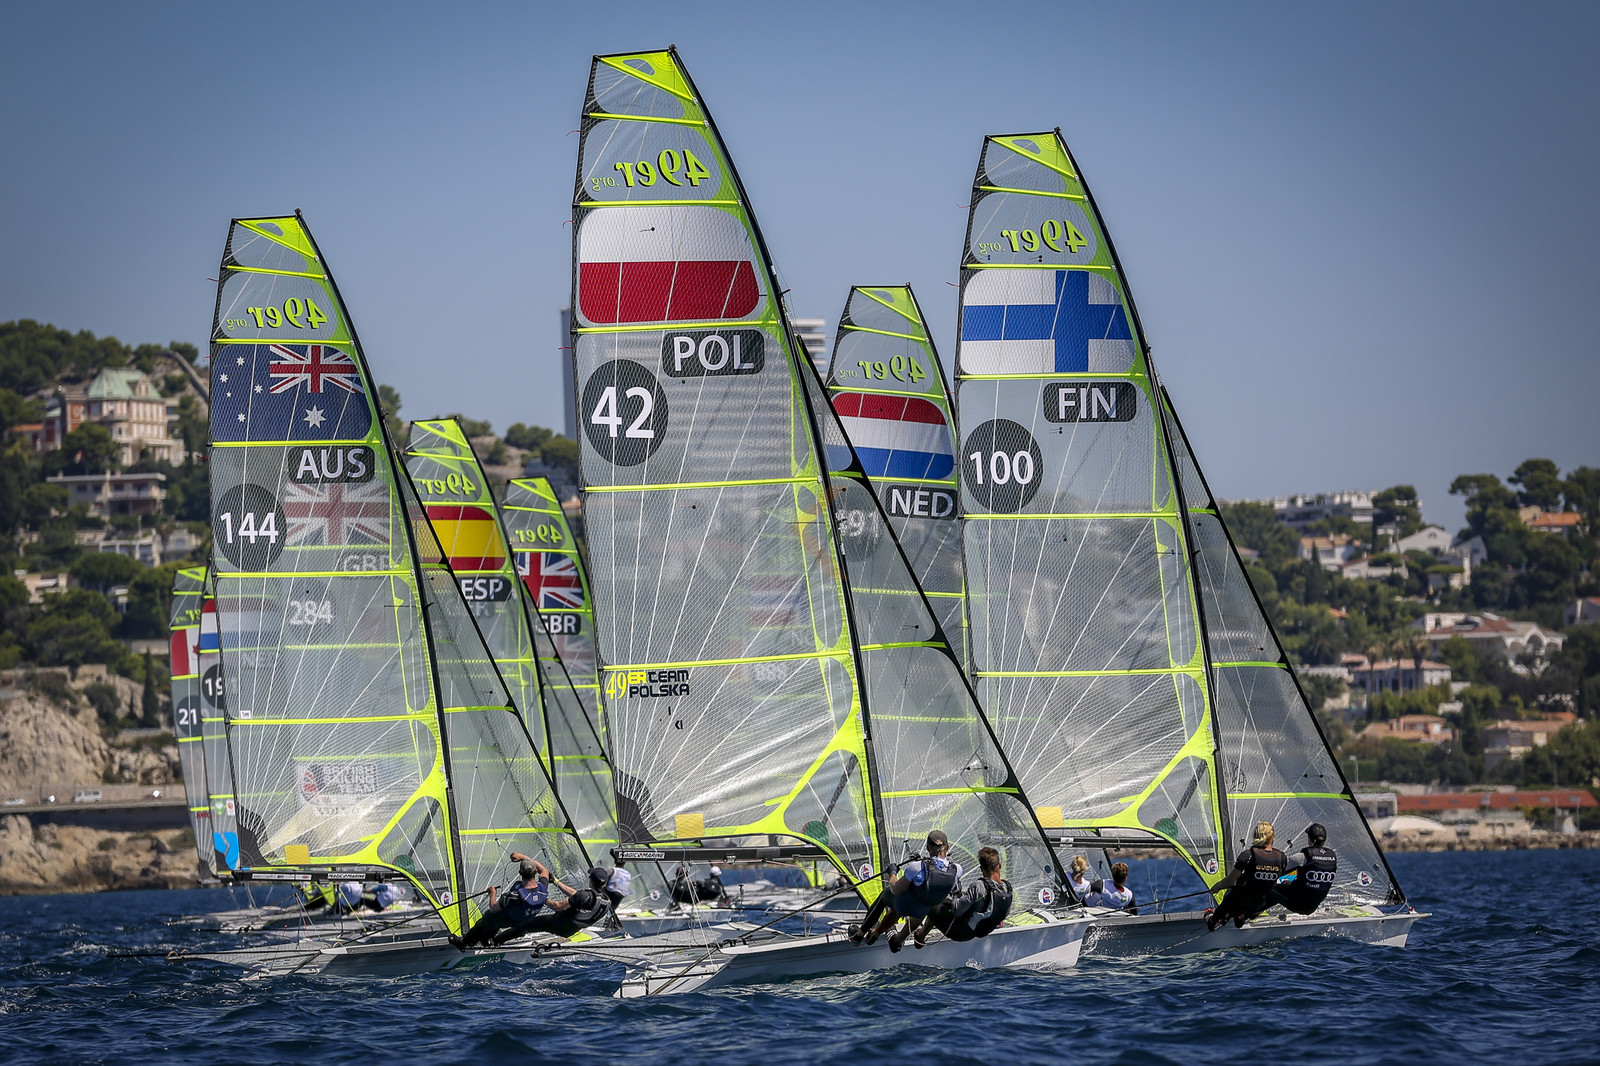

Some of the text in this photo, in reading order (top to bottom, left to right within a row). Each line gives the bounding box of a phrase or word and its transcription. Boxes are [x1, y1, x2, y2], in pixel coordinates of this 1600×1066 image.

[673, 334, 755, 372] POL
[591, 386, 655, 439] 42
[1058, 387, 1117, 419] FIN
[296, 448, 366, 479] AUS
[970, 450, 1034, 485] 100
[891, 488, 954, 518] NED
[220, 511, 279, 544] 144
[460, 578, 504, 600] ESP
[289, 600, 334, 625] 284
[629, 684, 690, 698] POLSKA
[648, 669, 689, 683] TEAM
